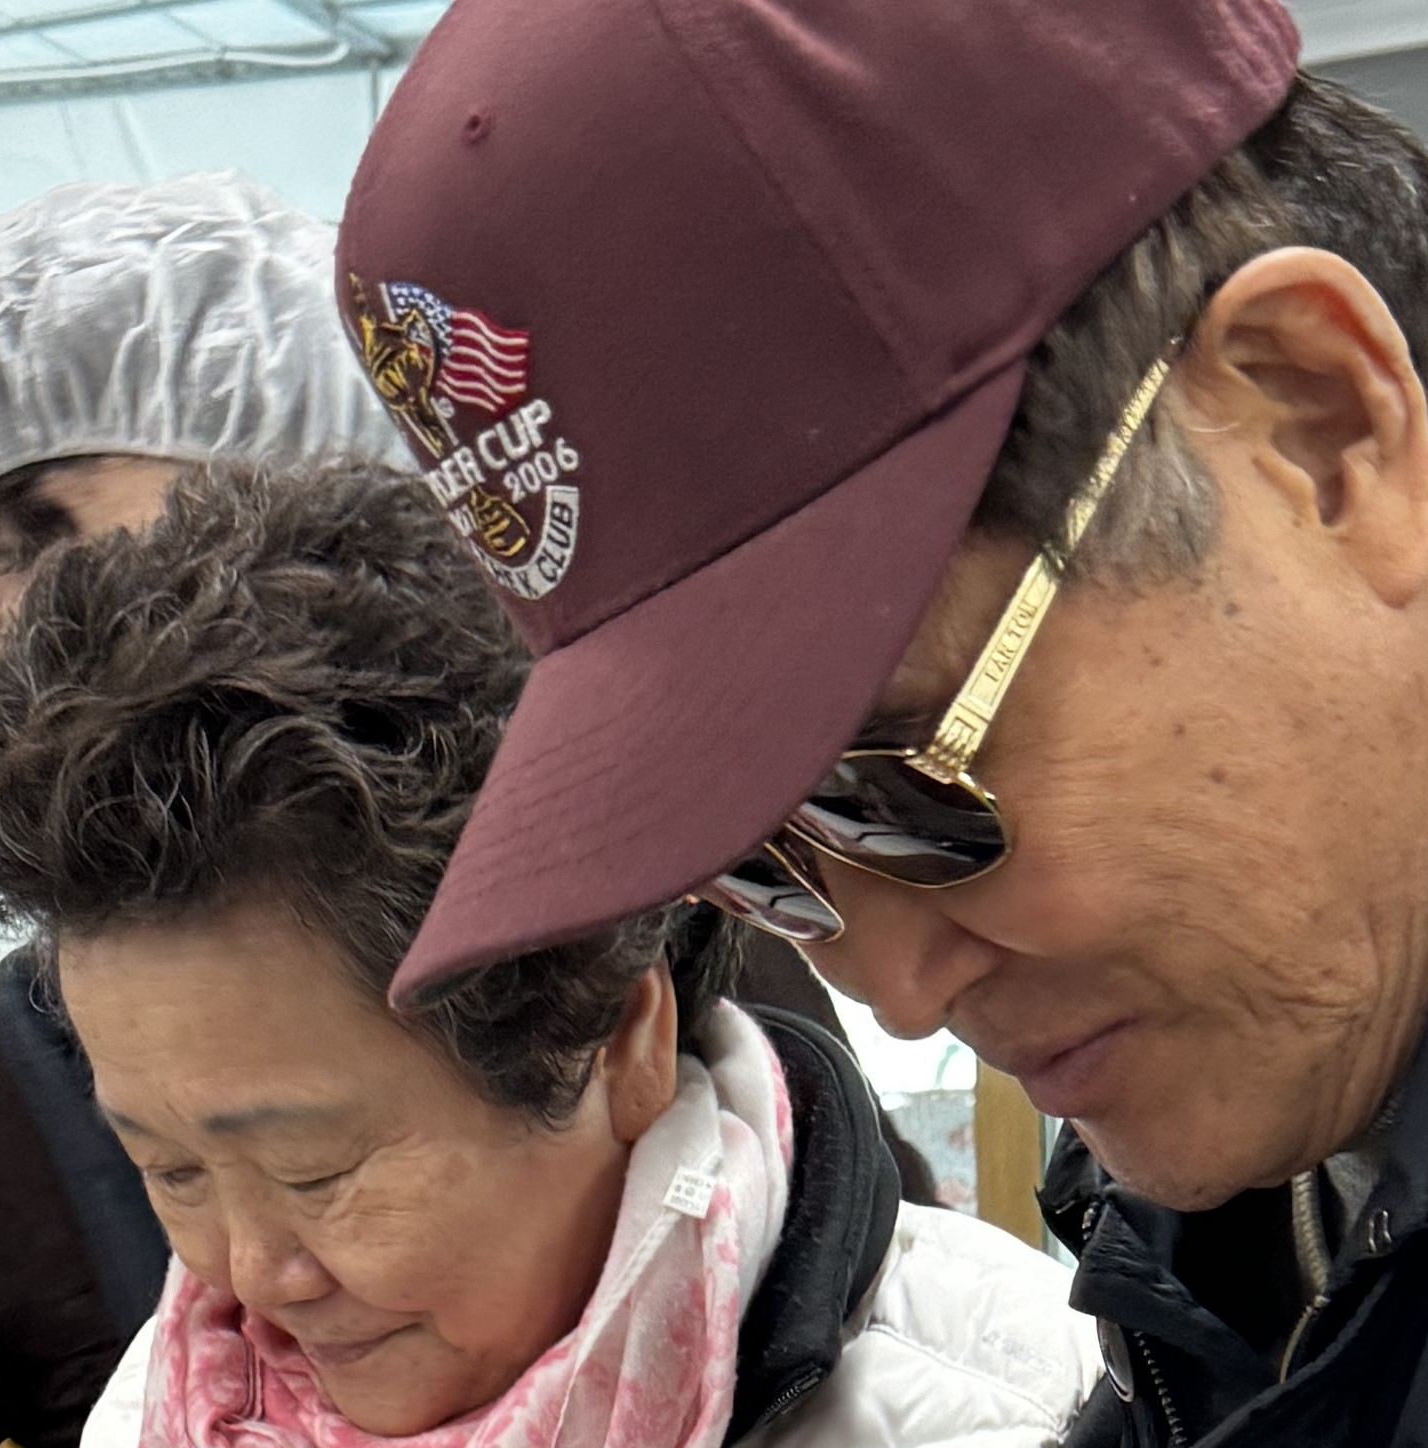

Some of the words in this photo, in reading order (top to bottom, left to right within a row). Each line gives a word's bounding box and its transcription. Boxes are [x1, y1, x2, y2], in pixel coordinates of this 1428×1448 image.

[476, 399, 552, 470] CUP
[503, 436, 579, 504] 2006
[535, 501, 573, 584] CLUB
